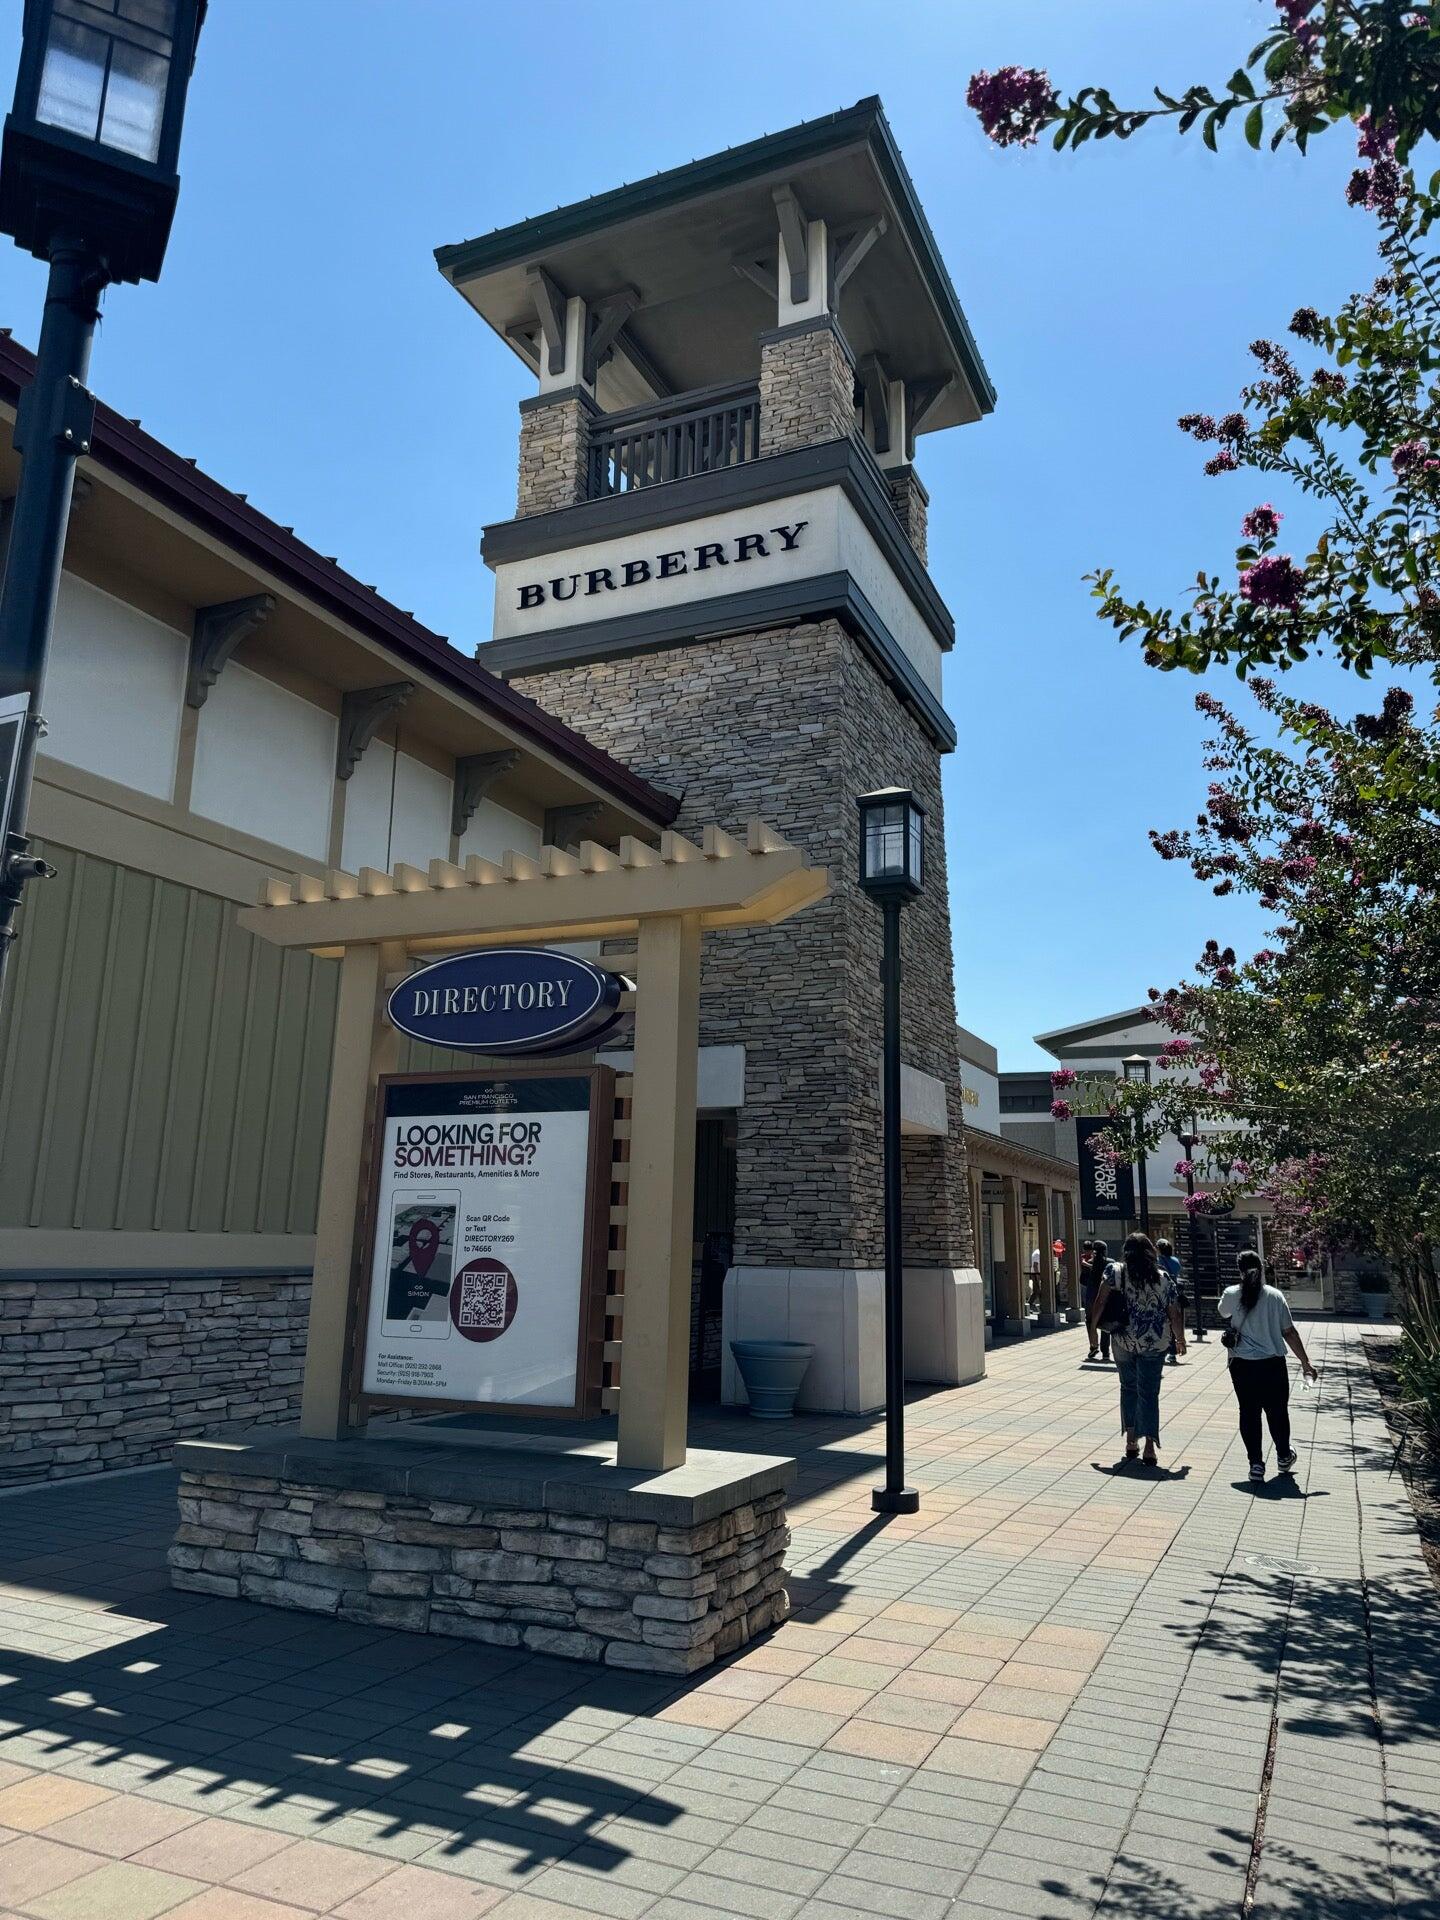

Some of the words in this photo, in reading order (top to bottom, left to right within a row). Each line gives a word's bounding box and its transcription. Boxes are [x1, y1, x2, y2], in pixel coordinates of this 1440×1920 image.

[516, 521, 809, 611] BURBERRY
[412, 979, 574, 1017] DIRECTORY
[478, 1092, 515, 1100] FRANCISCO
[396, 1123, 494, 1147] LOOKING
[499, 1122, 542, 1144] FOR
[393, 1143, 537, 1168] SOMETHING?
[393, 1171, 408, 1180] Find
[410, 1170, 433, 1180] Stores,
[434, 1170, 476, 1180] Restaurants,
[478, 1170, 512, 1178] Amenities
[514, 1170, 520, 1178] &
[520, 1170, 540, 1178] More
[1094, 1163, 1107, 1198] YORK
[1104, 1168, 1118, 1200] PADE
[466, 1214, 482, 1222] Scan
